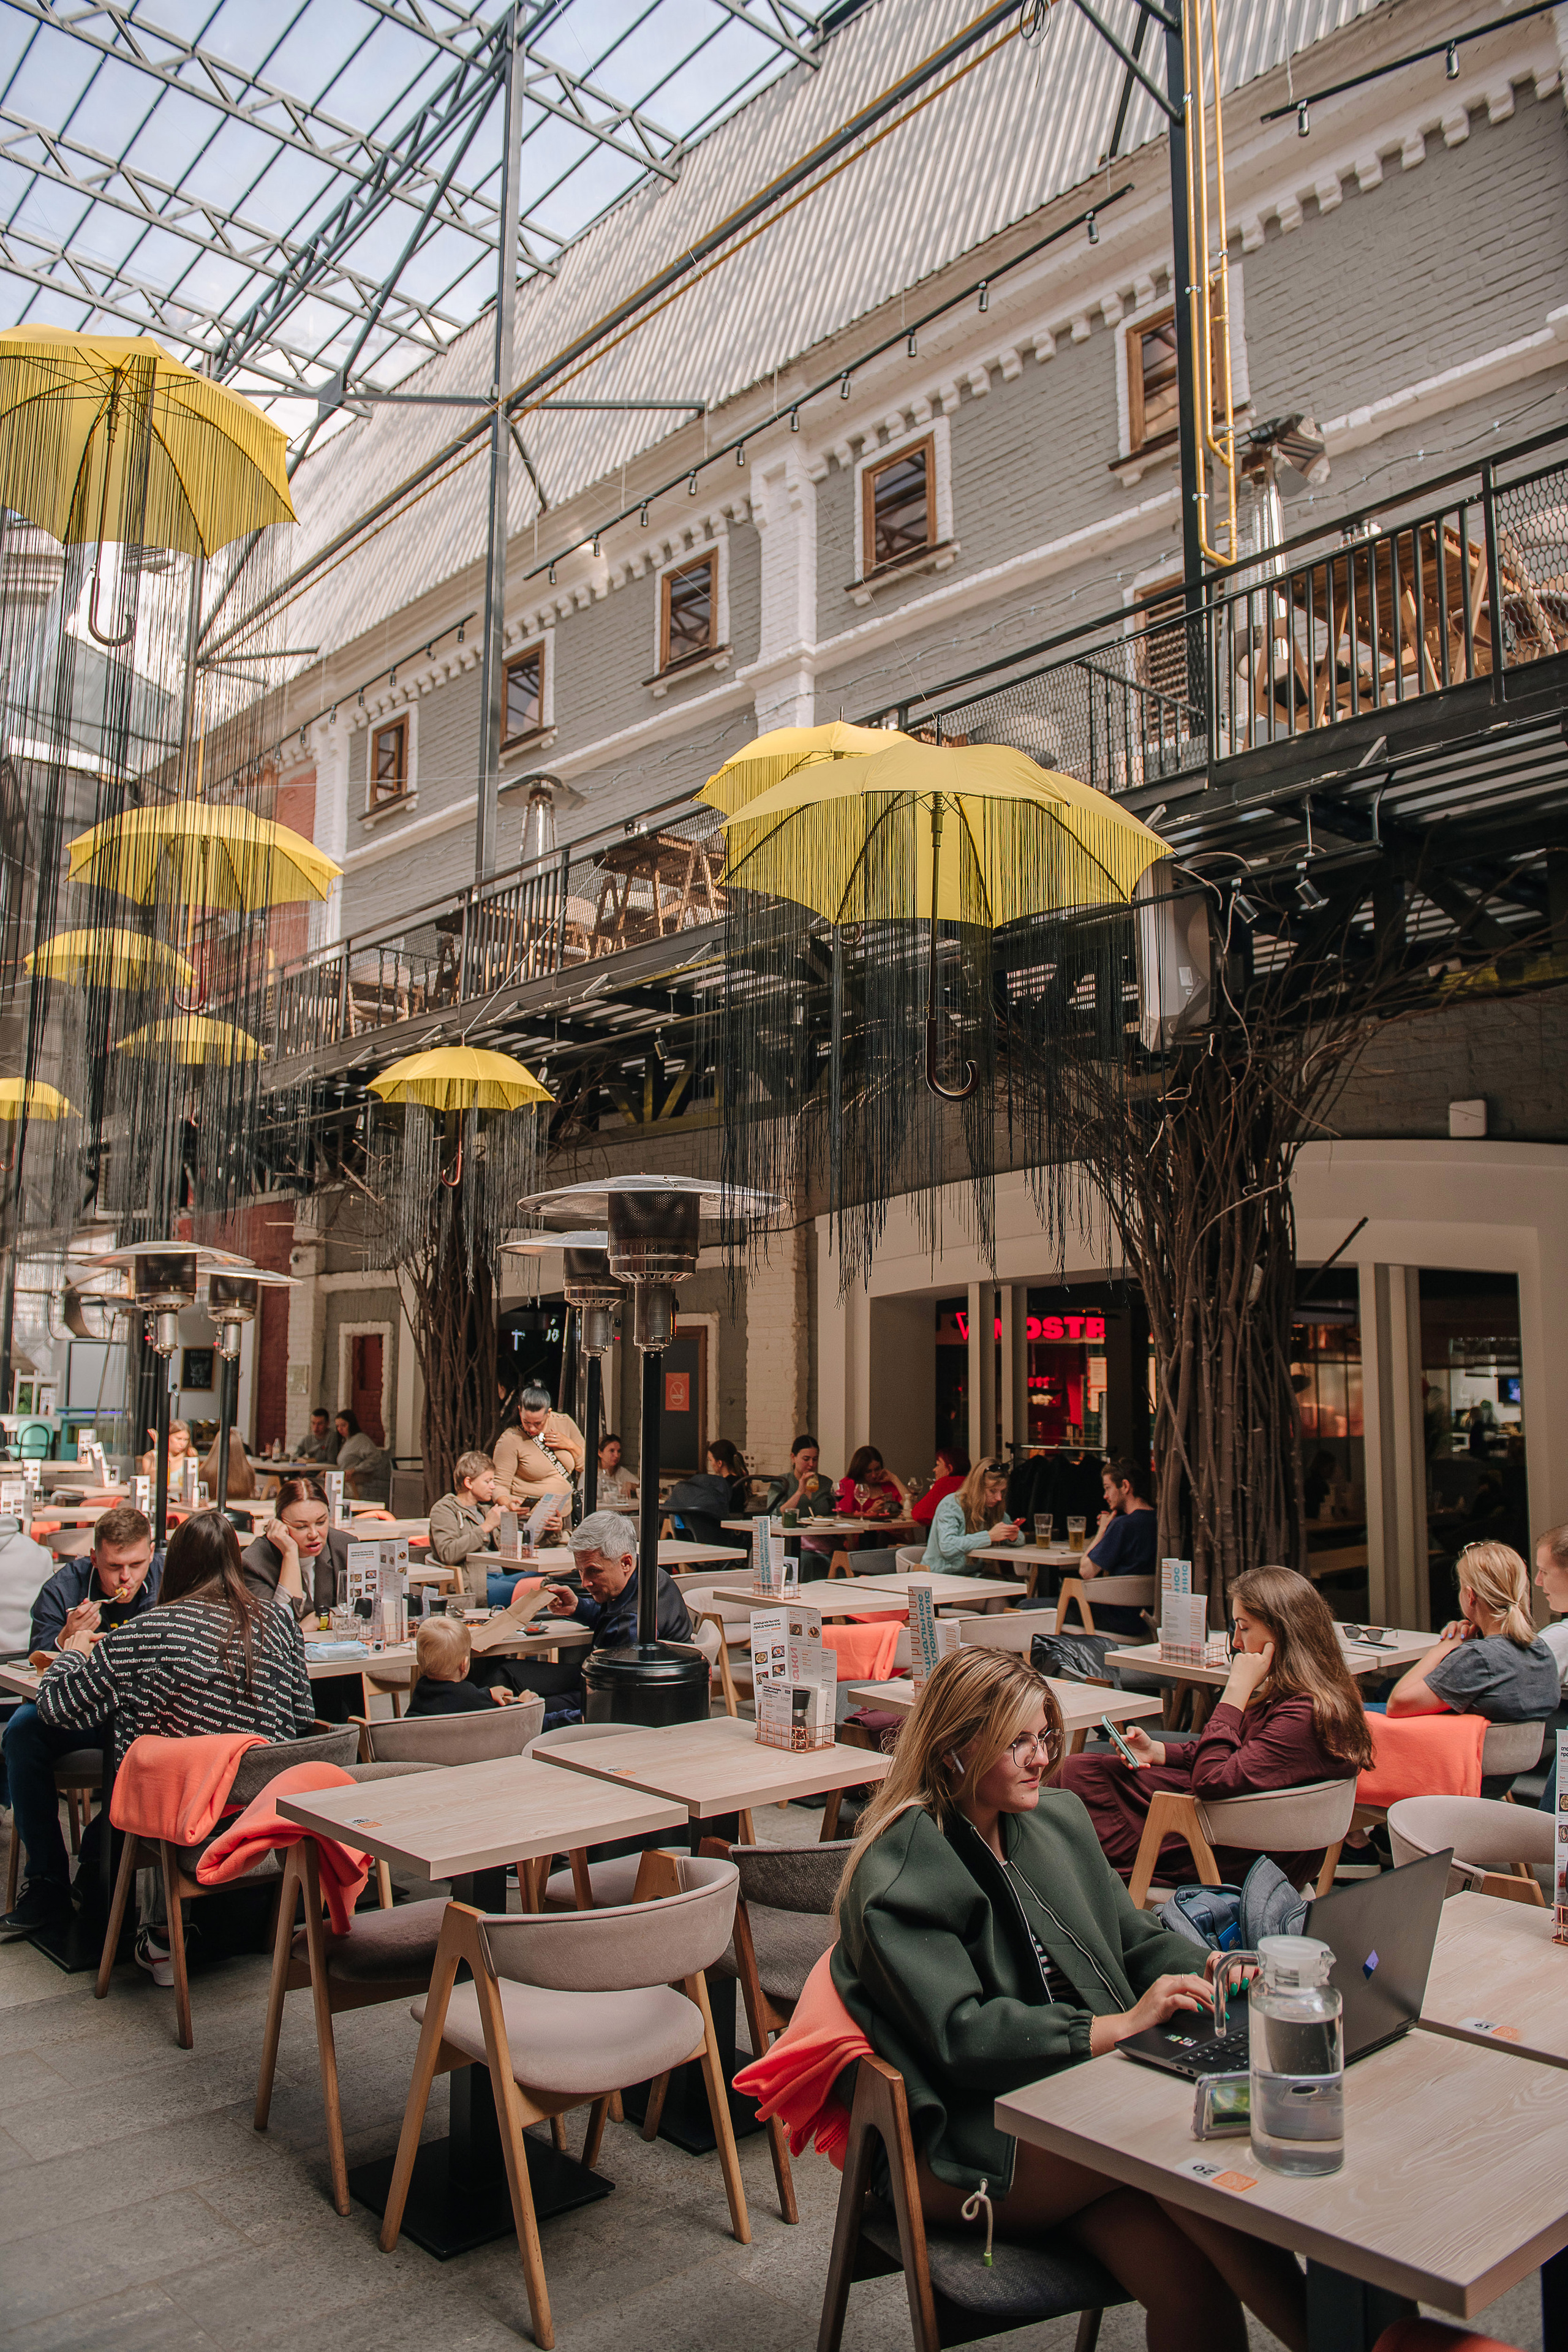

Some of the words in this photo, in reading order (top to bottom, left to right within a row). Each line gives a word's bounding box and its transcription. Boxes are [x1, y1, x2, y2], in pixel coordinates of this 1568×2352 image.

[142, 1621, 195, 1632] alexanderwang
[175, 1613, 228, 1633] alexanderwang
[112, 1632, 161, 1641] alexanderwang
[167, 1632, 219, 1653] alexanderwang
[180, 1682, 232, 1705] alexanderwang
[213, 1680, 263, 1701] alexanderang
[173, 1702, 222, 1727] alexanderwang
[203, 1702, 255, 1724] alexanderwang
